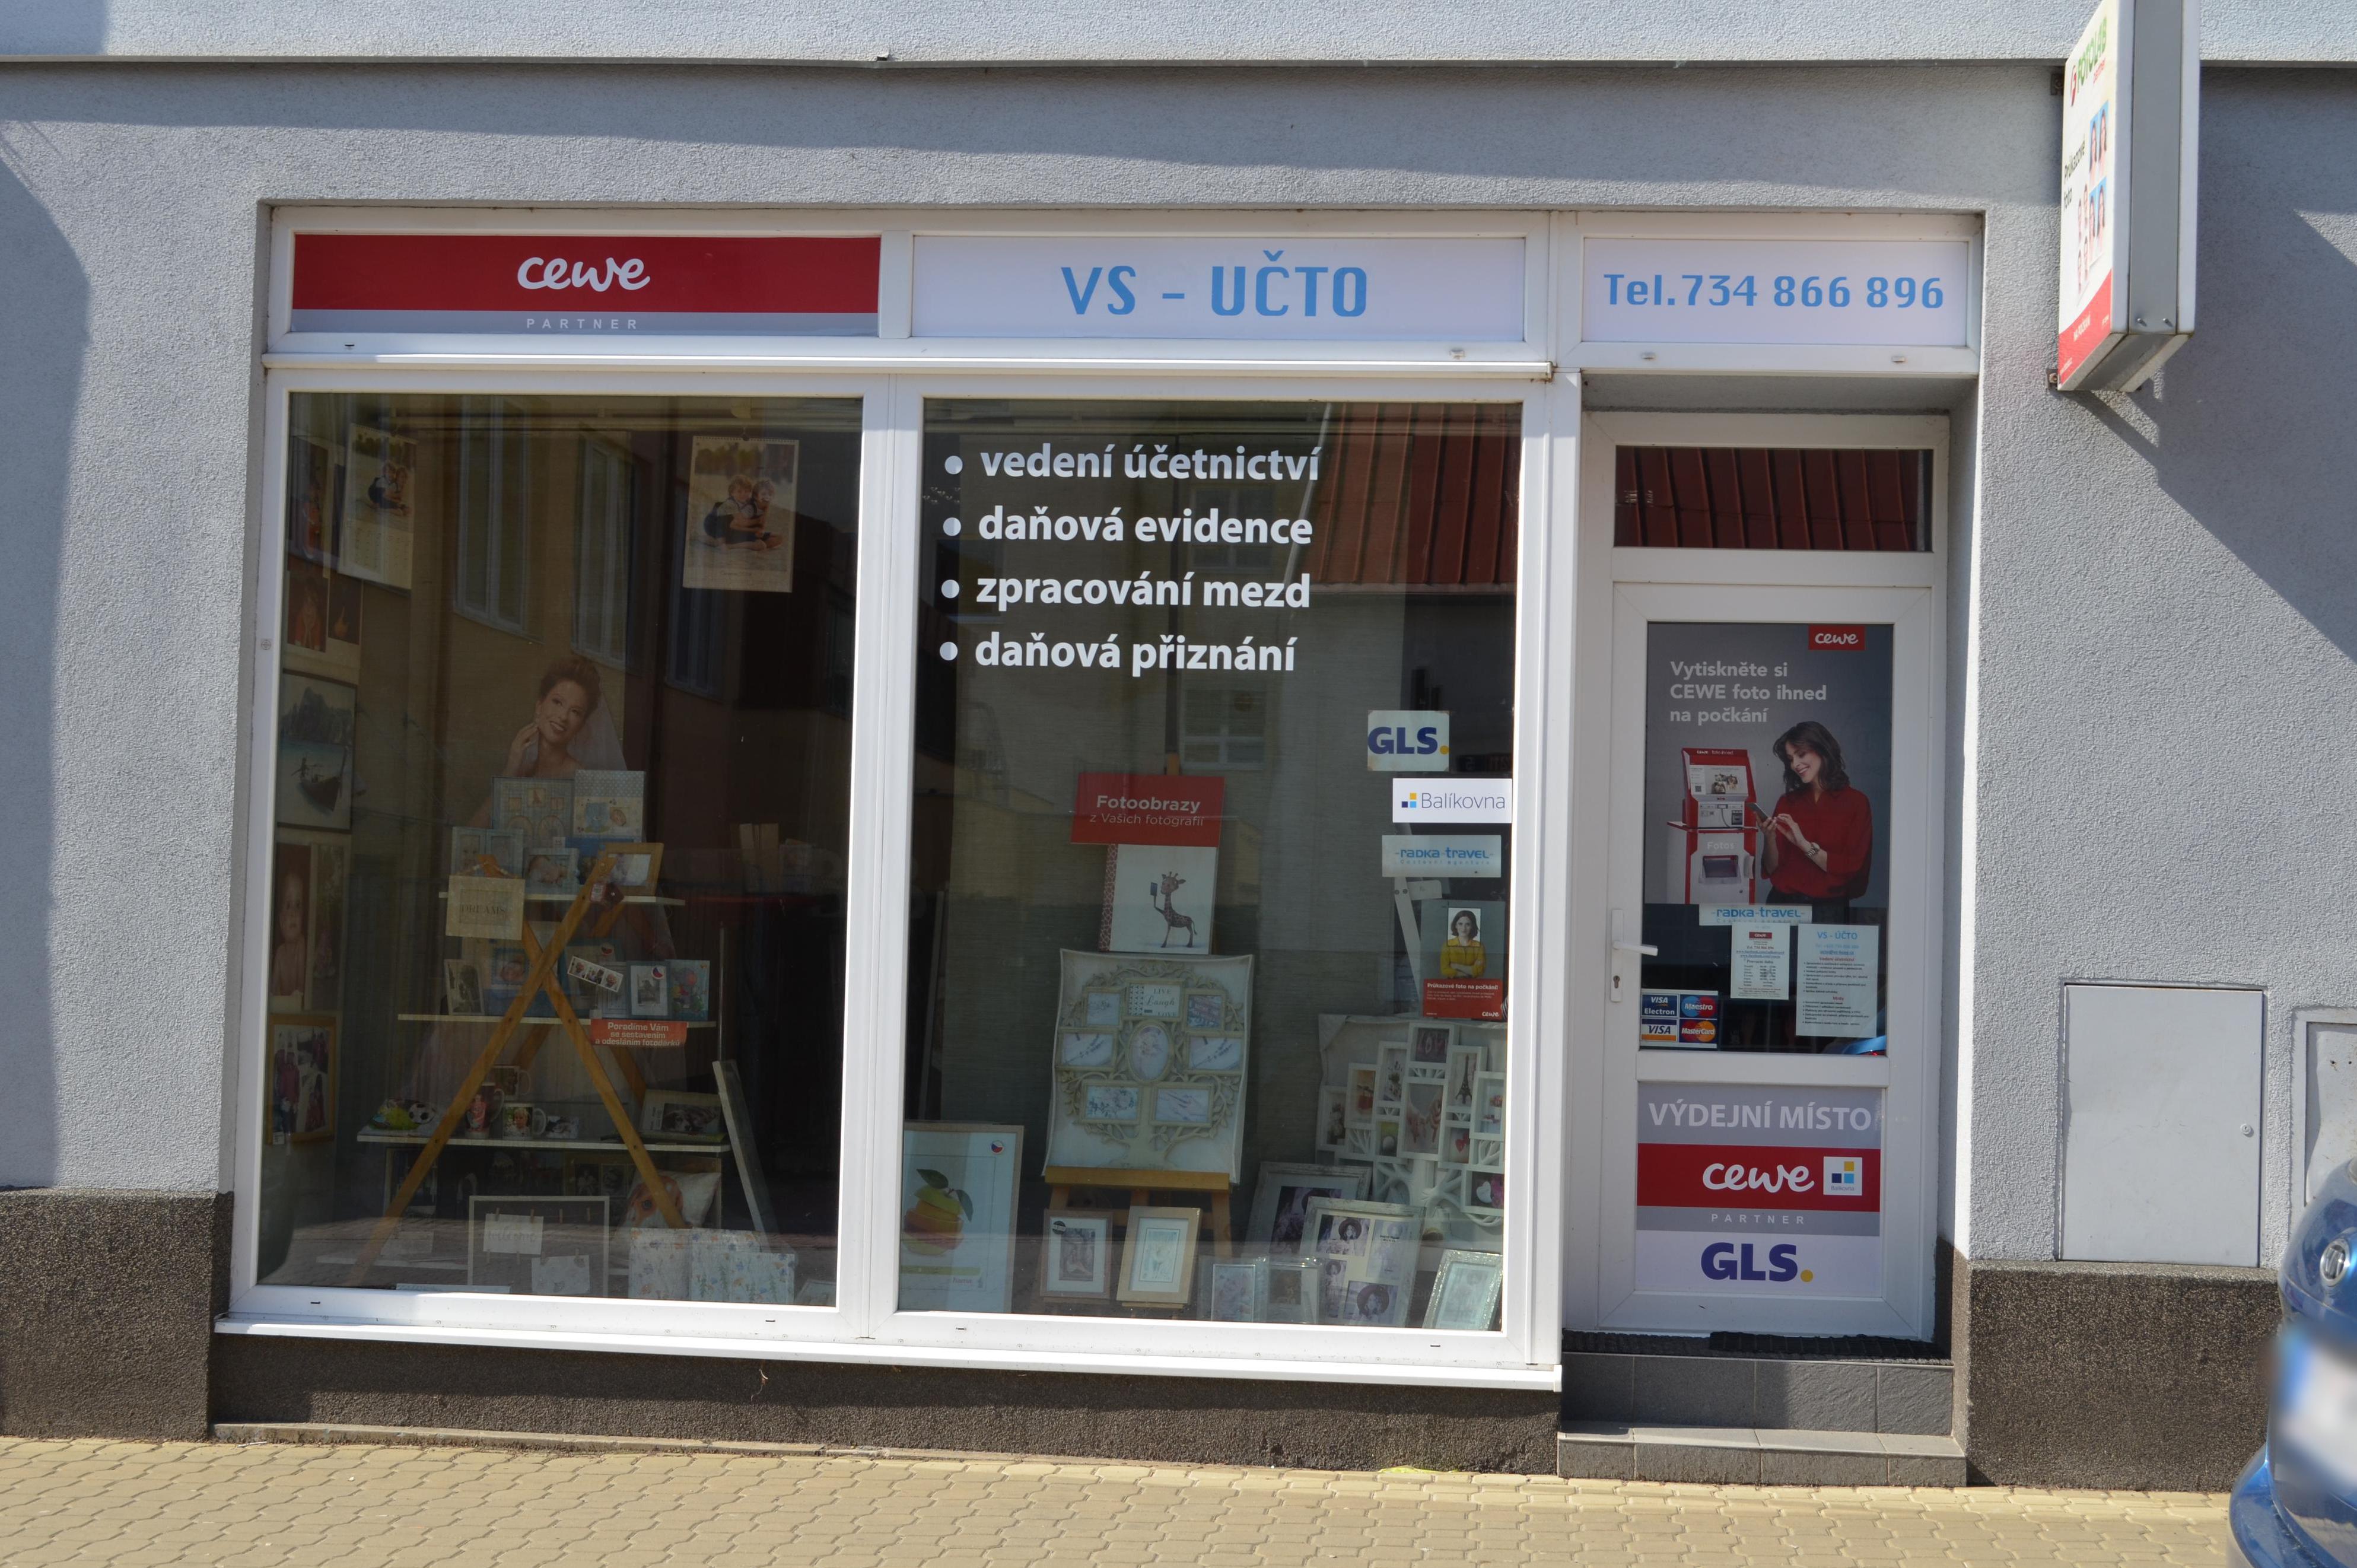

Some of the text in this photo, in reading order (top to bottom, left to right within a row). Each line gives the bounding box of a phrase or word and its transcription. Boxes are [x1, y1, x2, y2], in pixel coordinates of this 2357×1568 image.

[517, 256, 650, 292] cewe
[1060, 265, 1137, 316] VS
[1211, 250, 1368, 317] UČTO
[1604, 274, 1944, 308] Tel.734 866 896
[526, 318, 638, 330] PARTNER
[980, 443, 1322, 481] vedení účetnictví
[978, 505, 1313, 545] daňová evidence
[976, 571, 1310, 612] zpracování mezd
[1815, 632, 1859, 645] cewe
[975, 631, 1298, 678] daňová přiznání
[1669, 661, 1787, 680] Vytiskněte si
[1669, 684, 1827, 701] CEWE foto ihned
[1669, 707, 1769, 726] na počkání
[1096, 796, 1201, 814] Fotoobrazy
[1421, 792, 1506, 809] Balíkovna
[1090, 815, 1097, 823] z
[1100, 813, 1141, 824] Vašich
[460, 904, 505, 914] DREAMS
[1144, 995, 1175, 1008] Laugh
[607, 1022, 669, 1031] Poradíme Vám
[1648, 1025, 1671, 1034] VISA
[1647, 1098, 1872, 1131] VÝDEJNÍ MÍSTO
[1703, 1163, 1814, 1193] cewe
[1711, 1214, 1804, 1224] PARTNER
